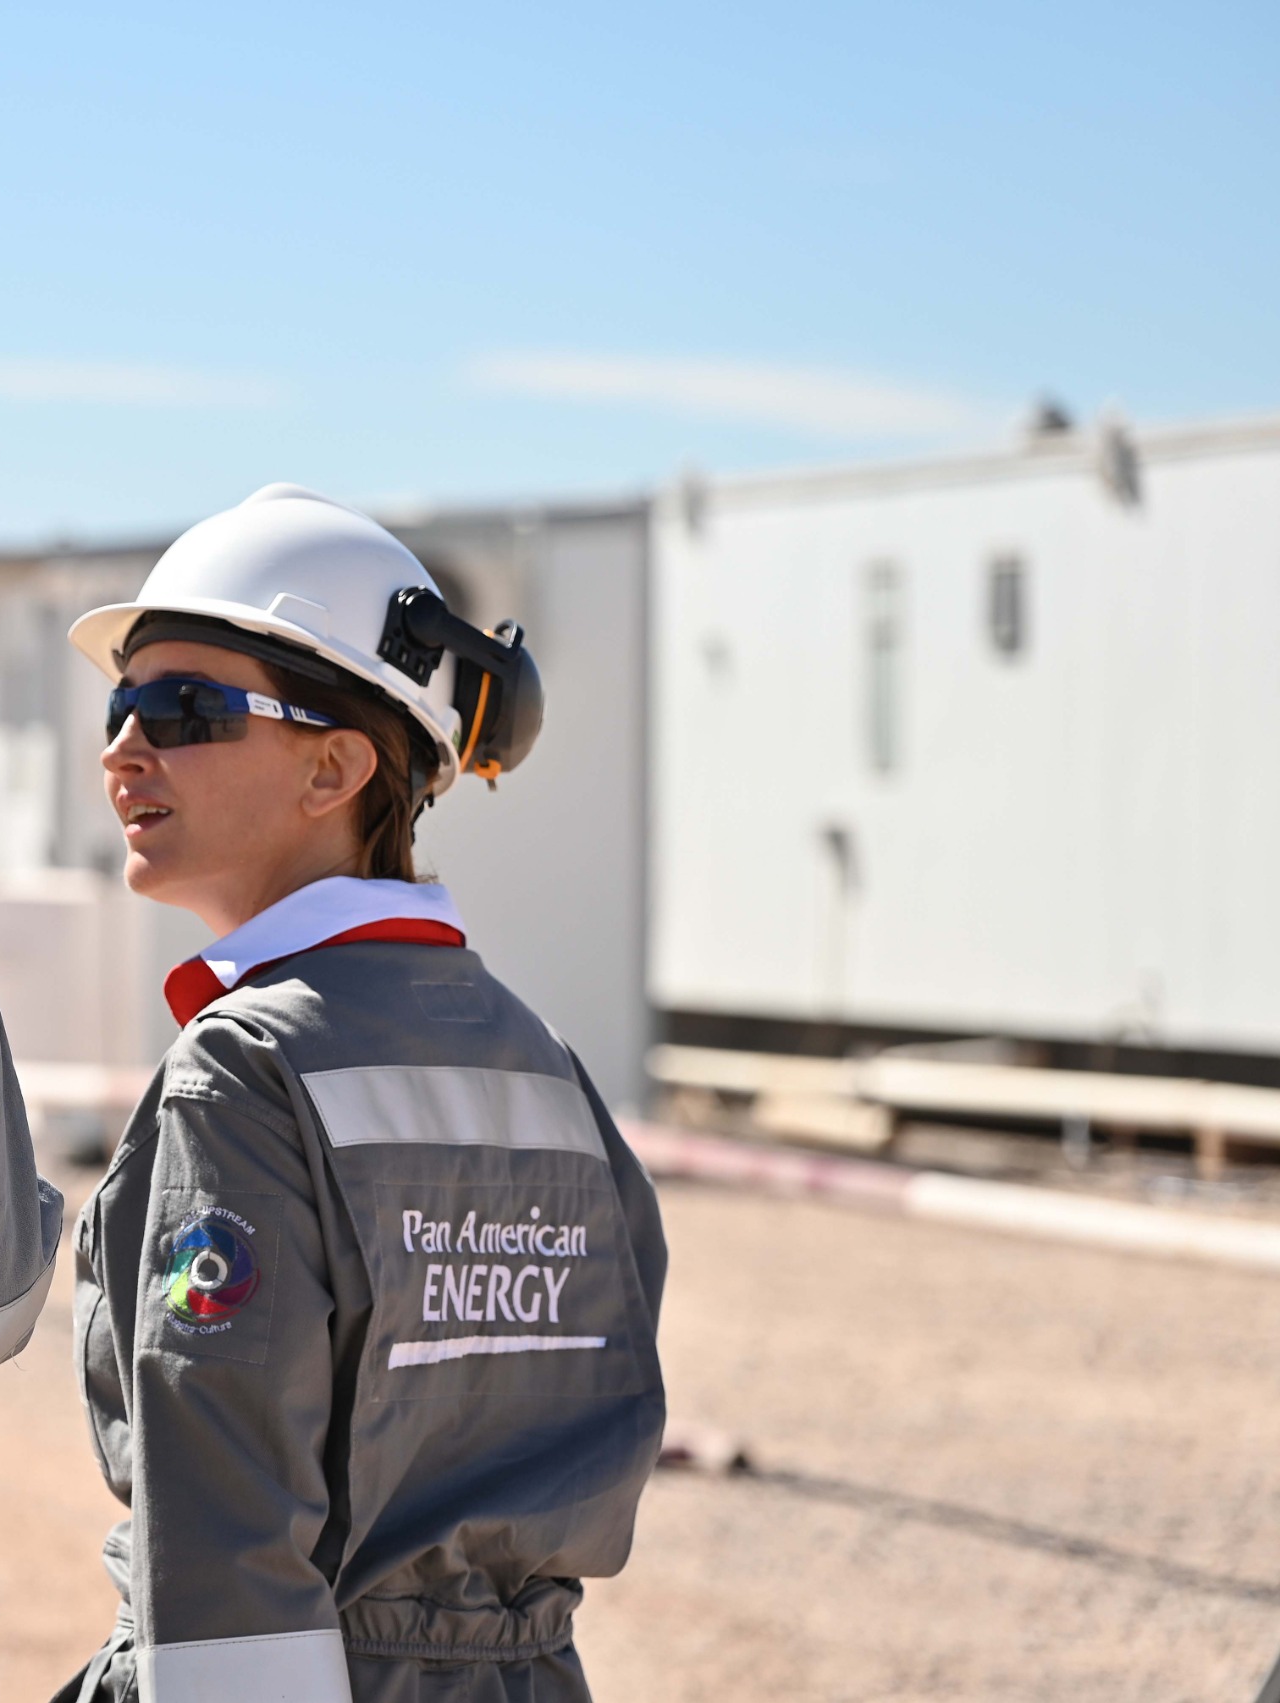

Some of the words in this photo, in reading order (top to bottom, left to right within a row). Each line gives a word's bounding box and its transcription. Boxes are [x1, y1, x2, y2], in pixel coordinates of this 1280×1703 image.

[402, 1209, 452, 1253] Pan
[455, 1206, 588, 1257] American
[422, 1263, 571, 1324] ENERGY
